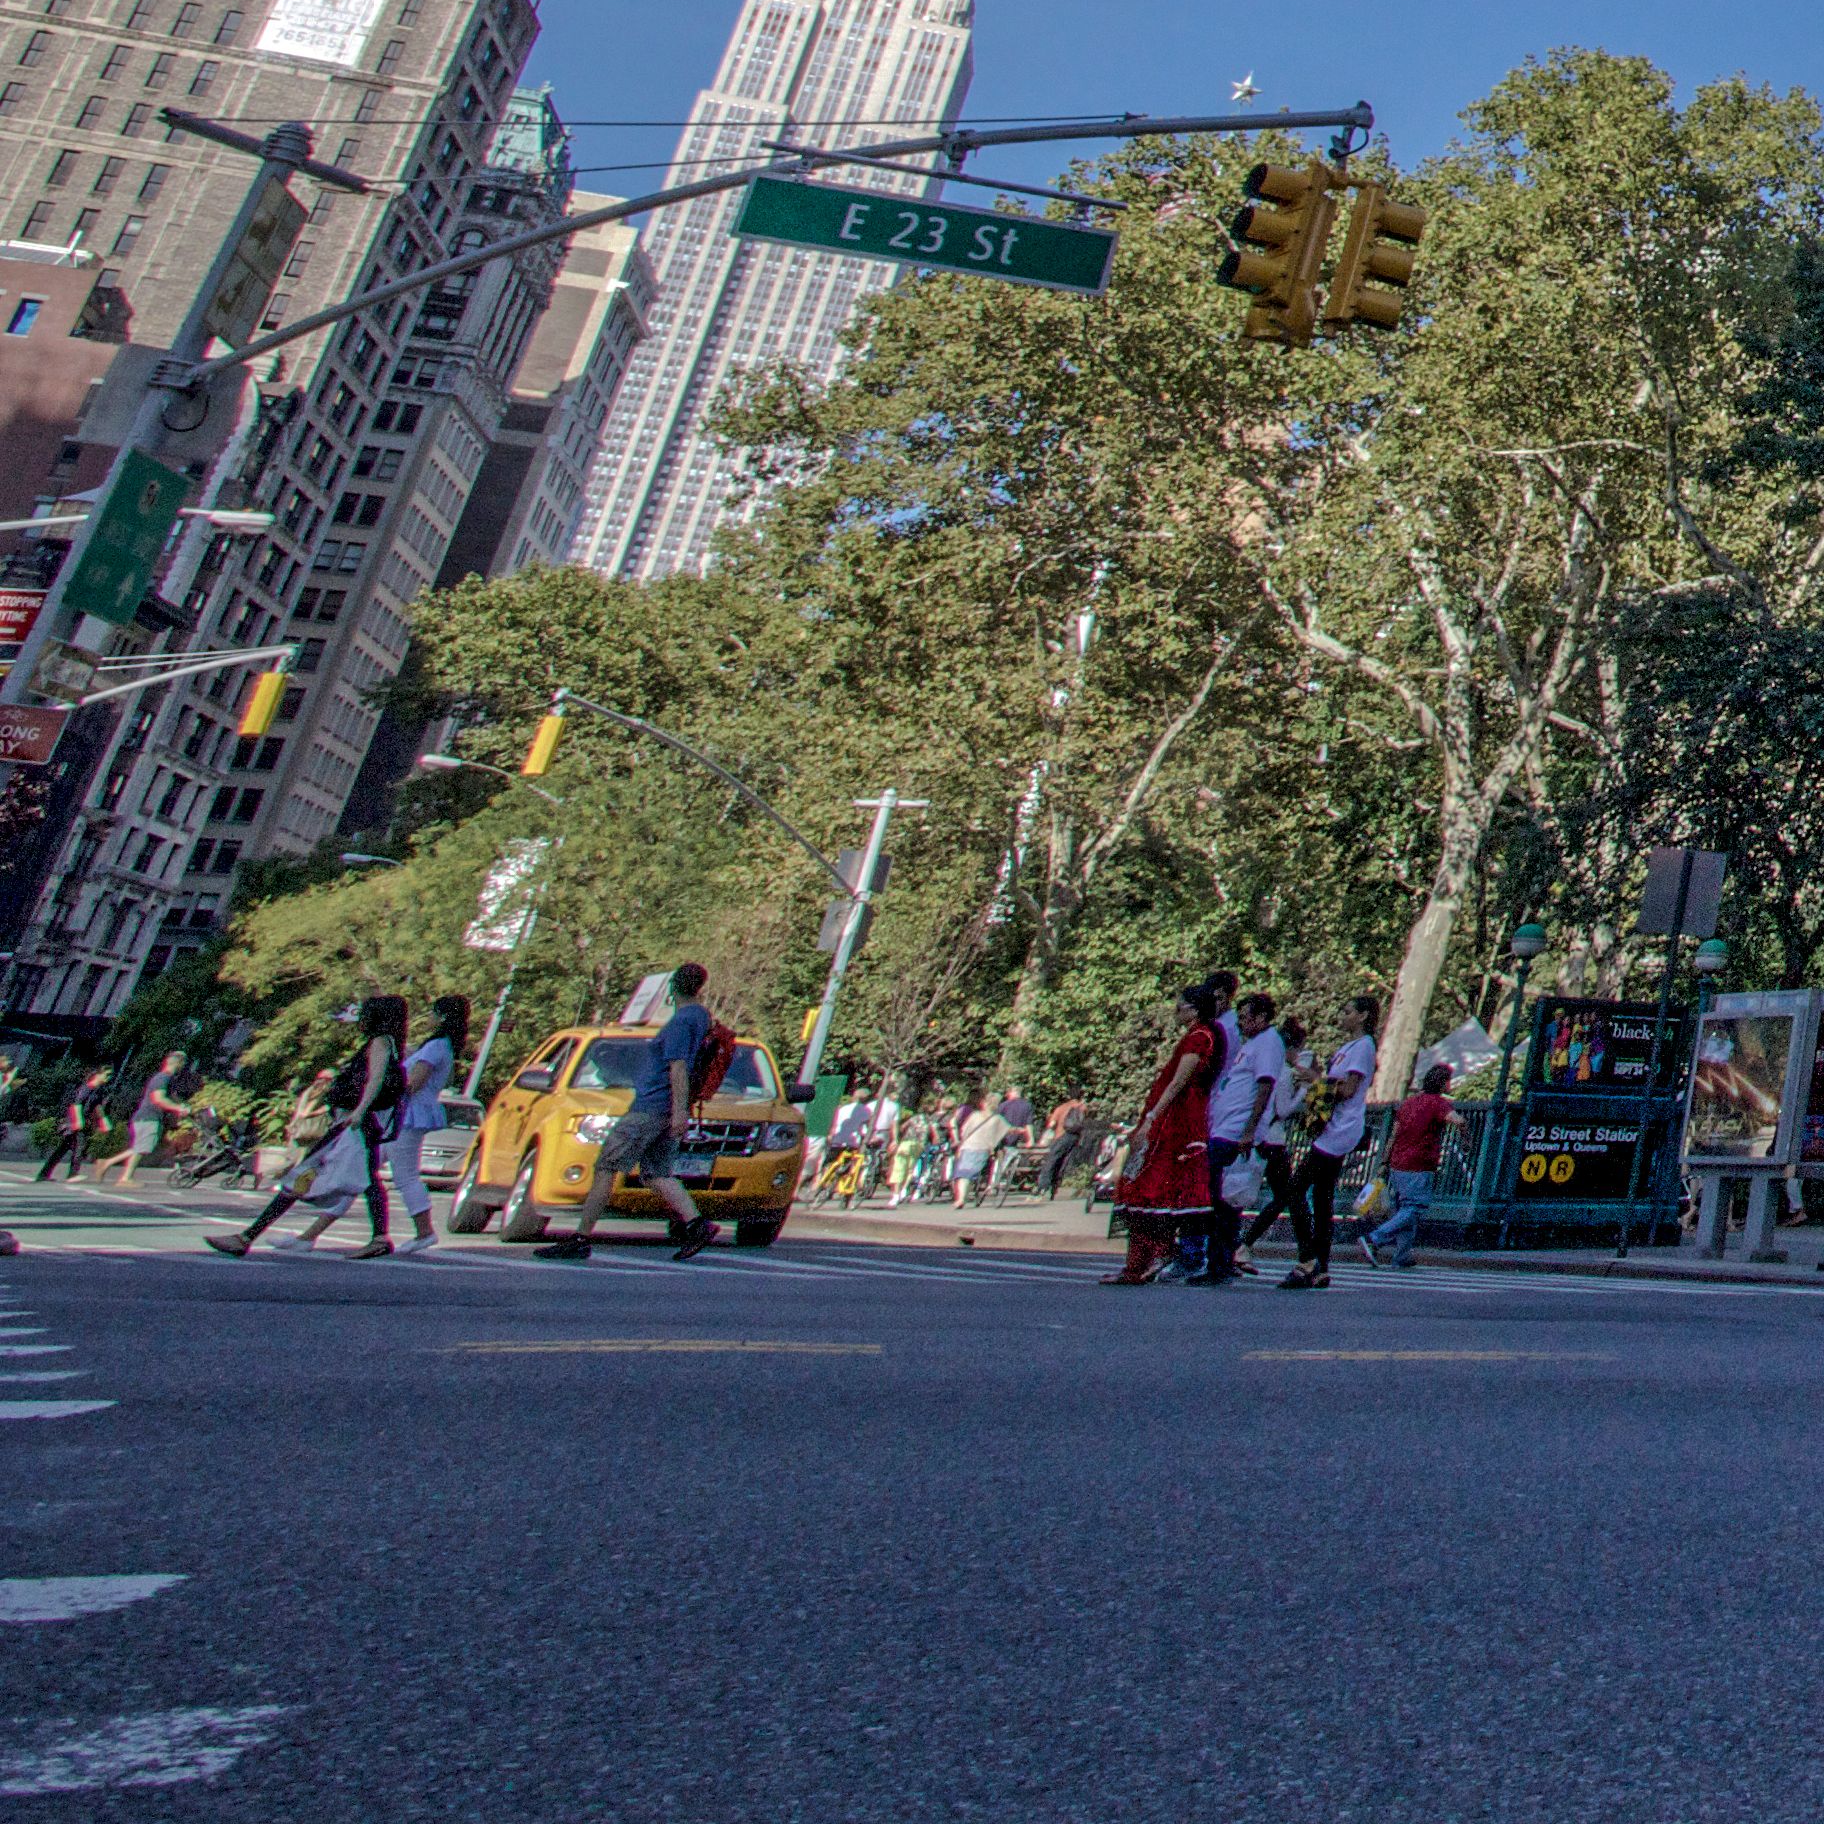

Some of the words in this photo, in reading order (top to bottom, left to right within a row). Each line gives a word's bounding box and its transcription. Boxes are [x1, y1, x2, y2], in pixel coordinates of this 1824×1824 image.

[838, 202, 871, 240] E
[889, 211, 949, 253] 23
[968, 224, 1019, 265] St
[1527, 1127, 1545, 1140] 23
[1550, 1128, 1590, 1140] Street
[1525, 1141, 1560, 1152] Uptown
[1563, 1143, 1569, 1152] &
[1573, 1143, 1608, 1153] Queens
[1527, 1161, 1540, 1176] N
[1556, 1161, 1570, 1176] R
